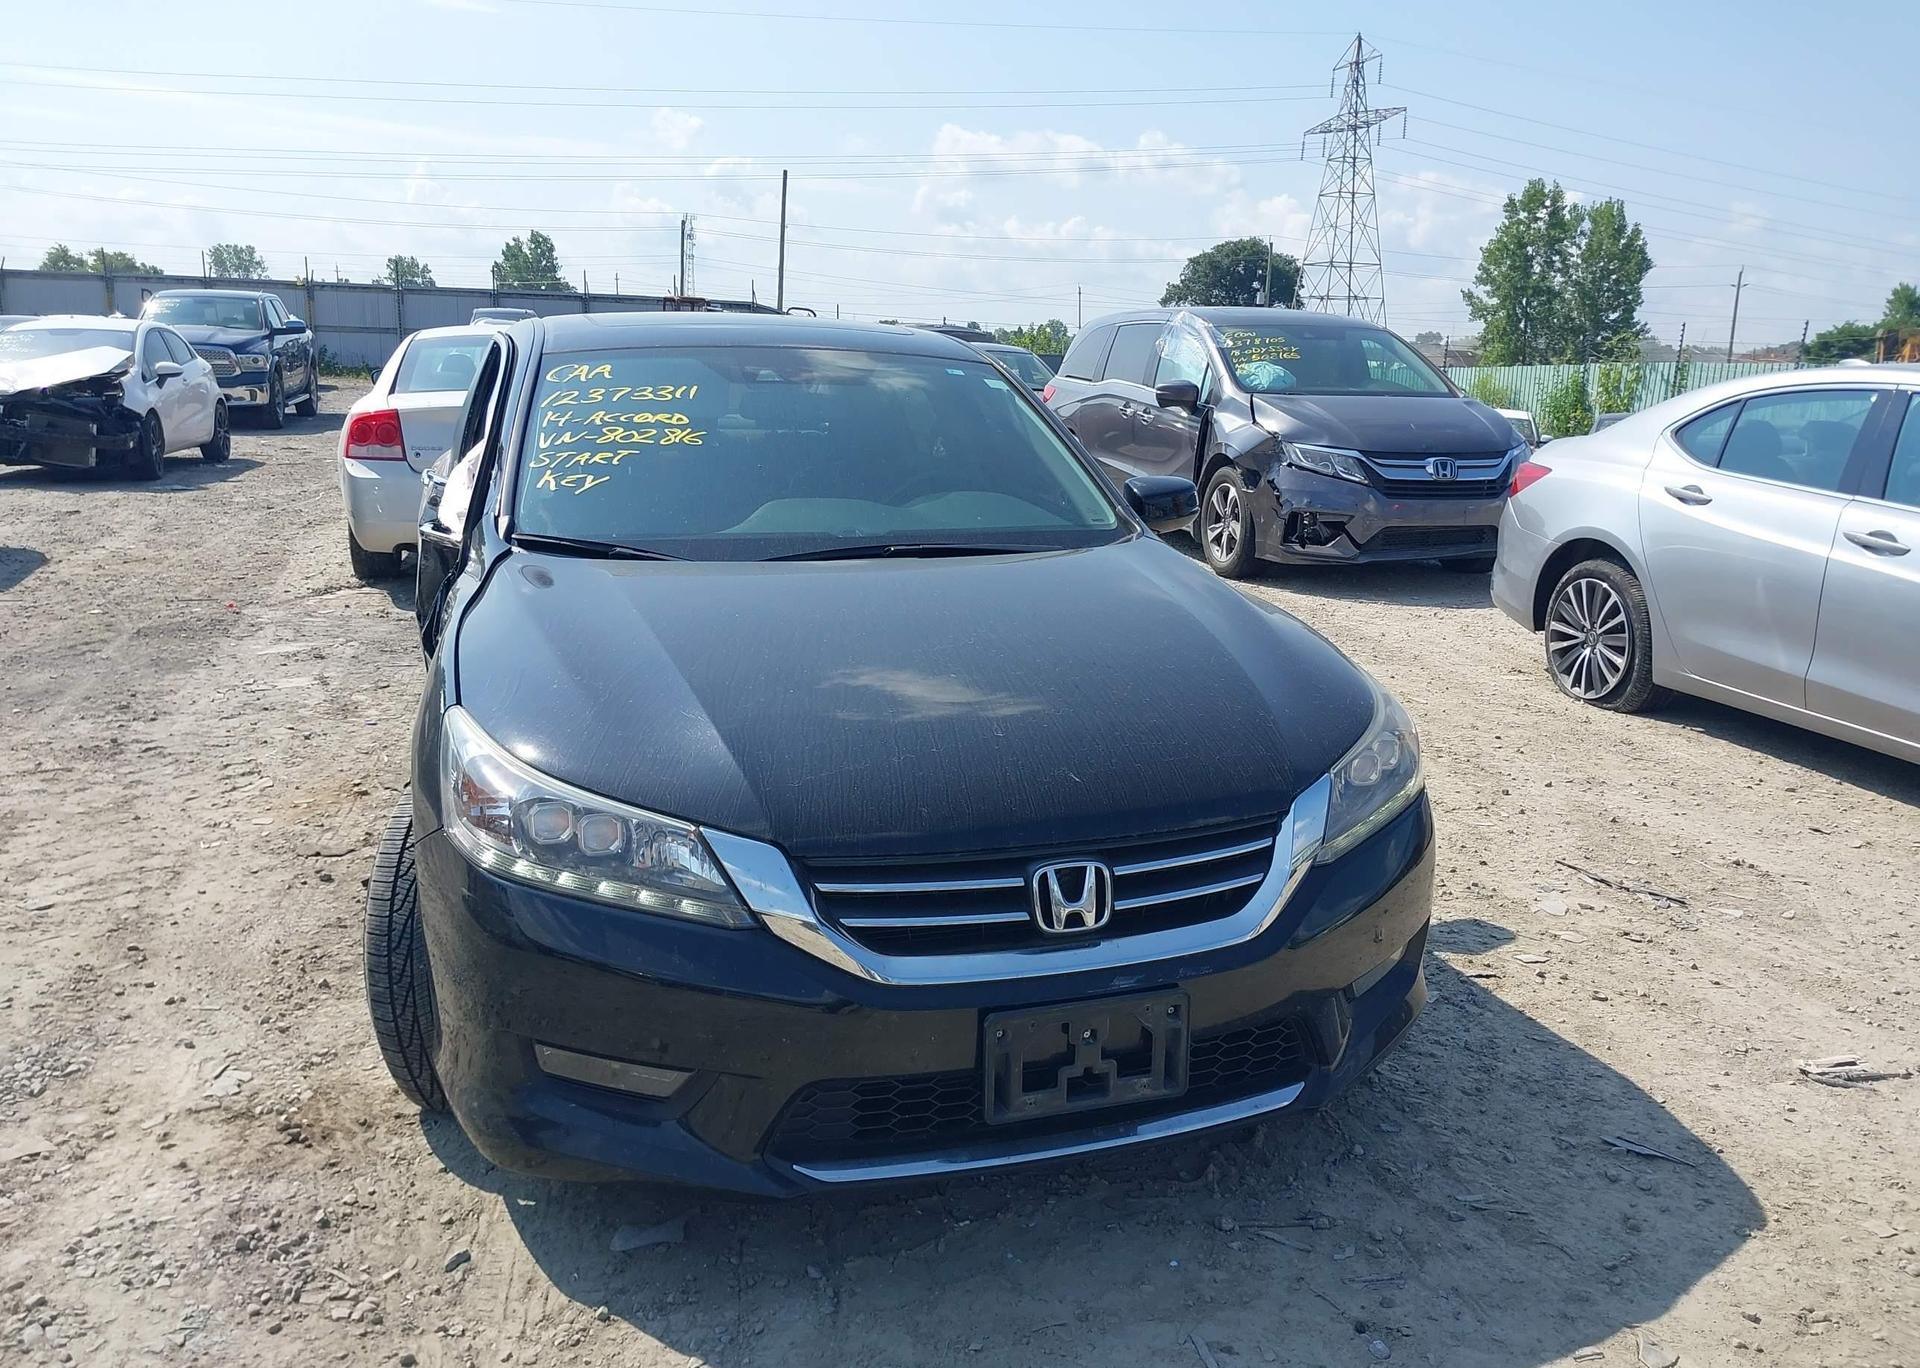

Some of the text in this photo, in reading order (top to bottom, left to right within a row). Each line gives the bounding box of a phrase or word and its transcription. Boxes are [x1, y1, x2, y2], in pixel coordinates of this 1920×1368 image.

[545, 364, 614, 382] CAA
[540, 385, 699, 408] 12373311
[541, 411, 690, 428] 14-ACCORD
[529, 450, 640, 468] START
